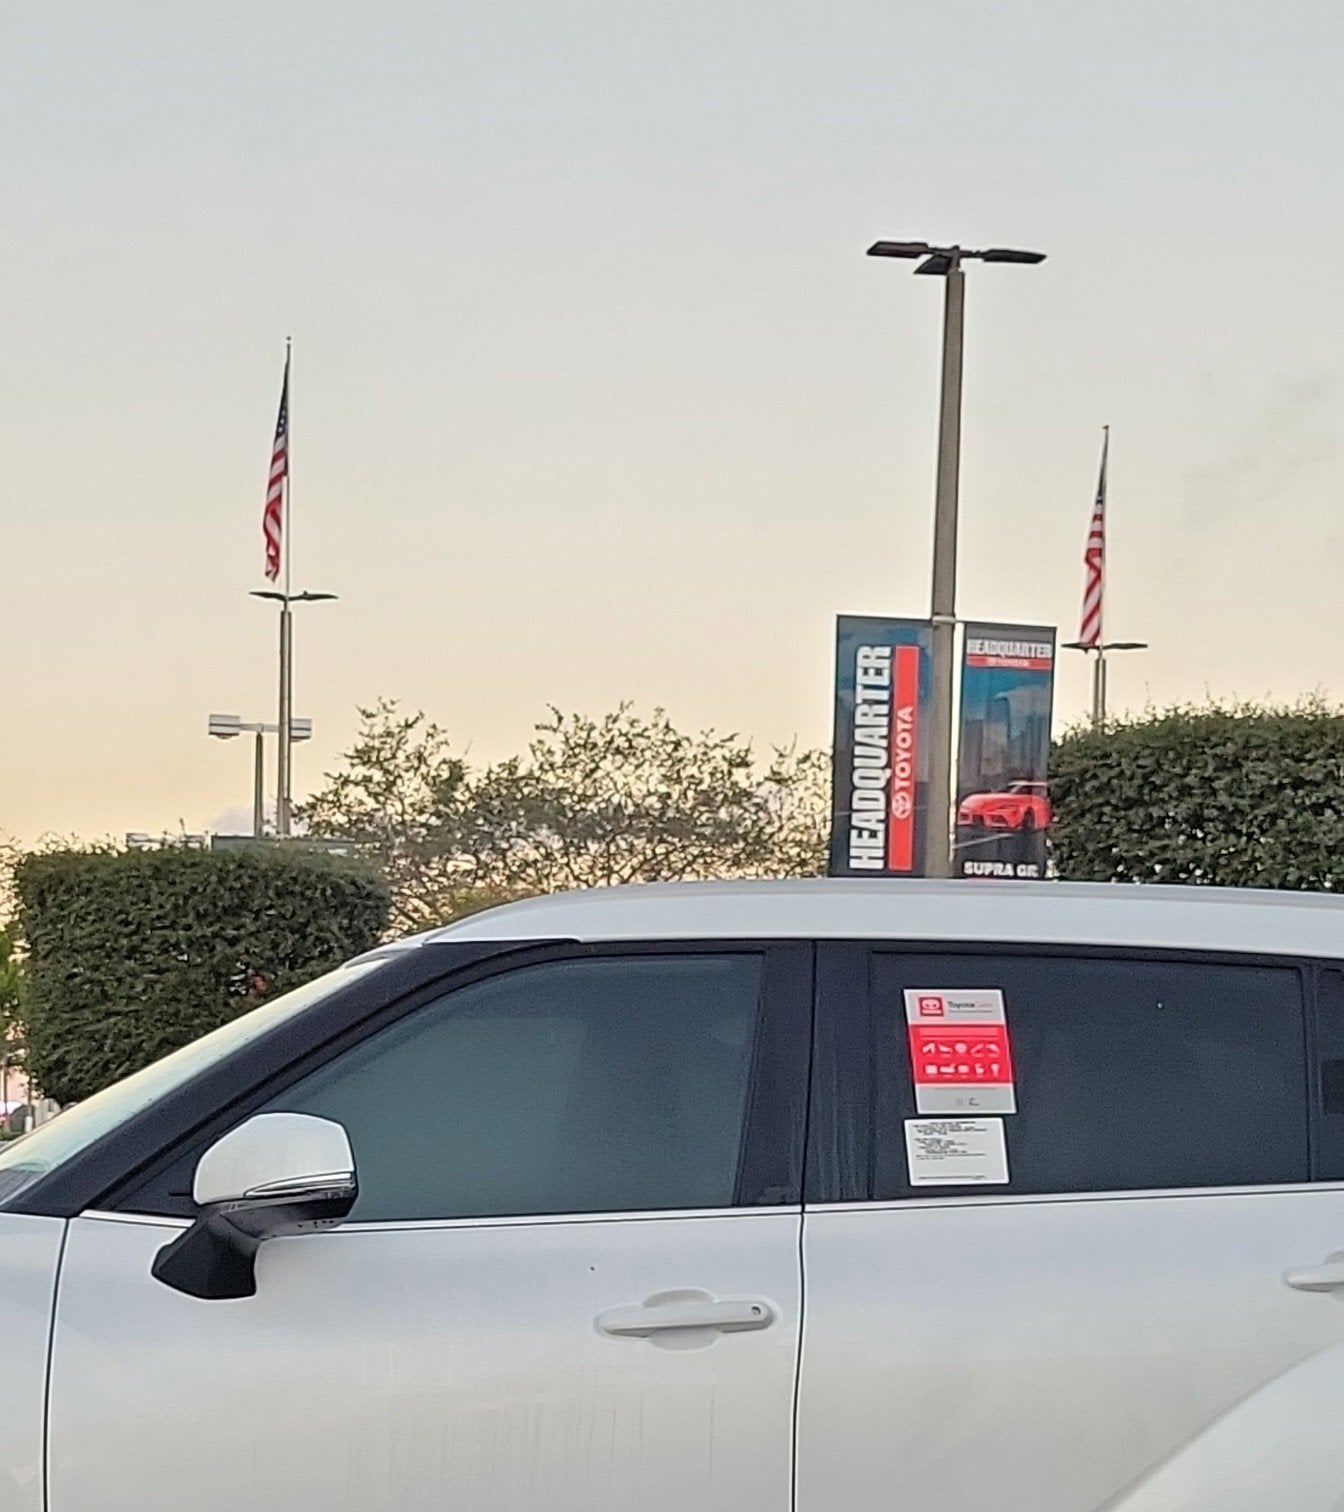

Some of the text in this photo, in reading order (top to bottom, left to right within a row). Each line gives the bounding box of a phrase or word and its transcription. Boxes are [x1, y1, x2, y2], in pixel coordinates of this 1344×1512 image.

[848, 644, 893, 871] HEADQUARTER
[894, 705, 915, 792] TOYOTA
[963, 860, 1015, 878] SUPRA
